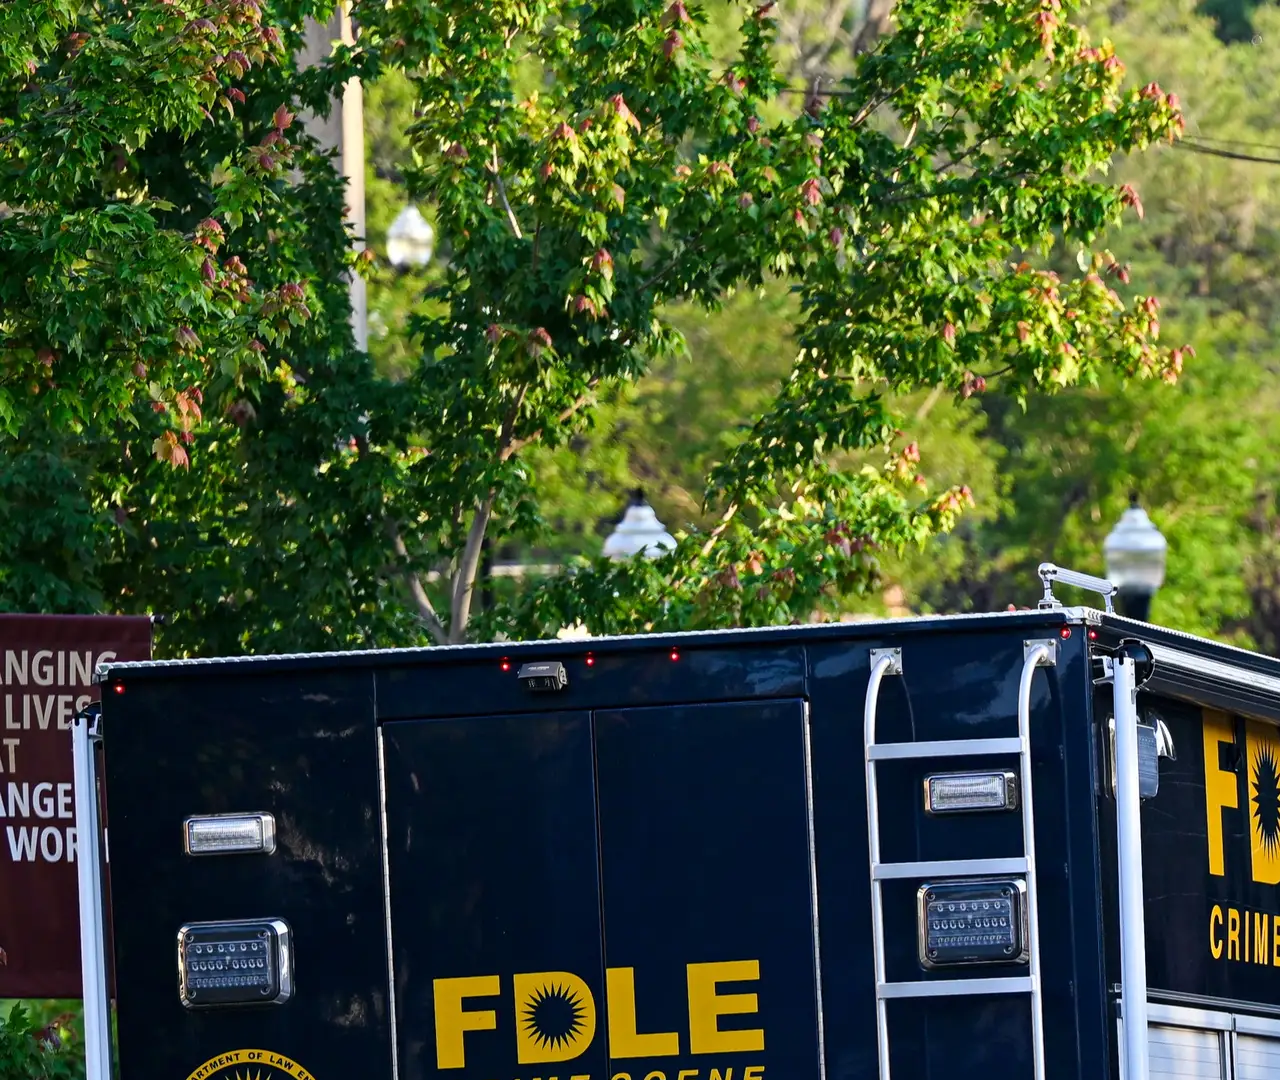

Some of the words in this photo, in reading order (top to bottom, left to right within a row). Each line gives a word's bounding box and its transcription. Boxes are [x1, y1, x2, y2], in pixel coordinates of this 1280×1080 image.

[432, 959, 765, 1070] FDLE
[248, 1051, 263, 1060] OF
[269, 1054, 294, 1071] LAW
